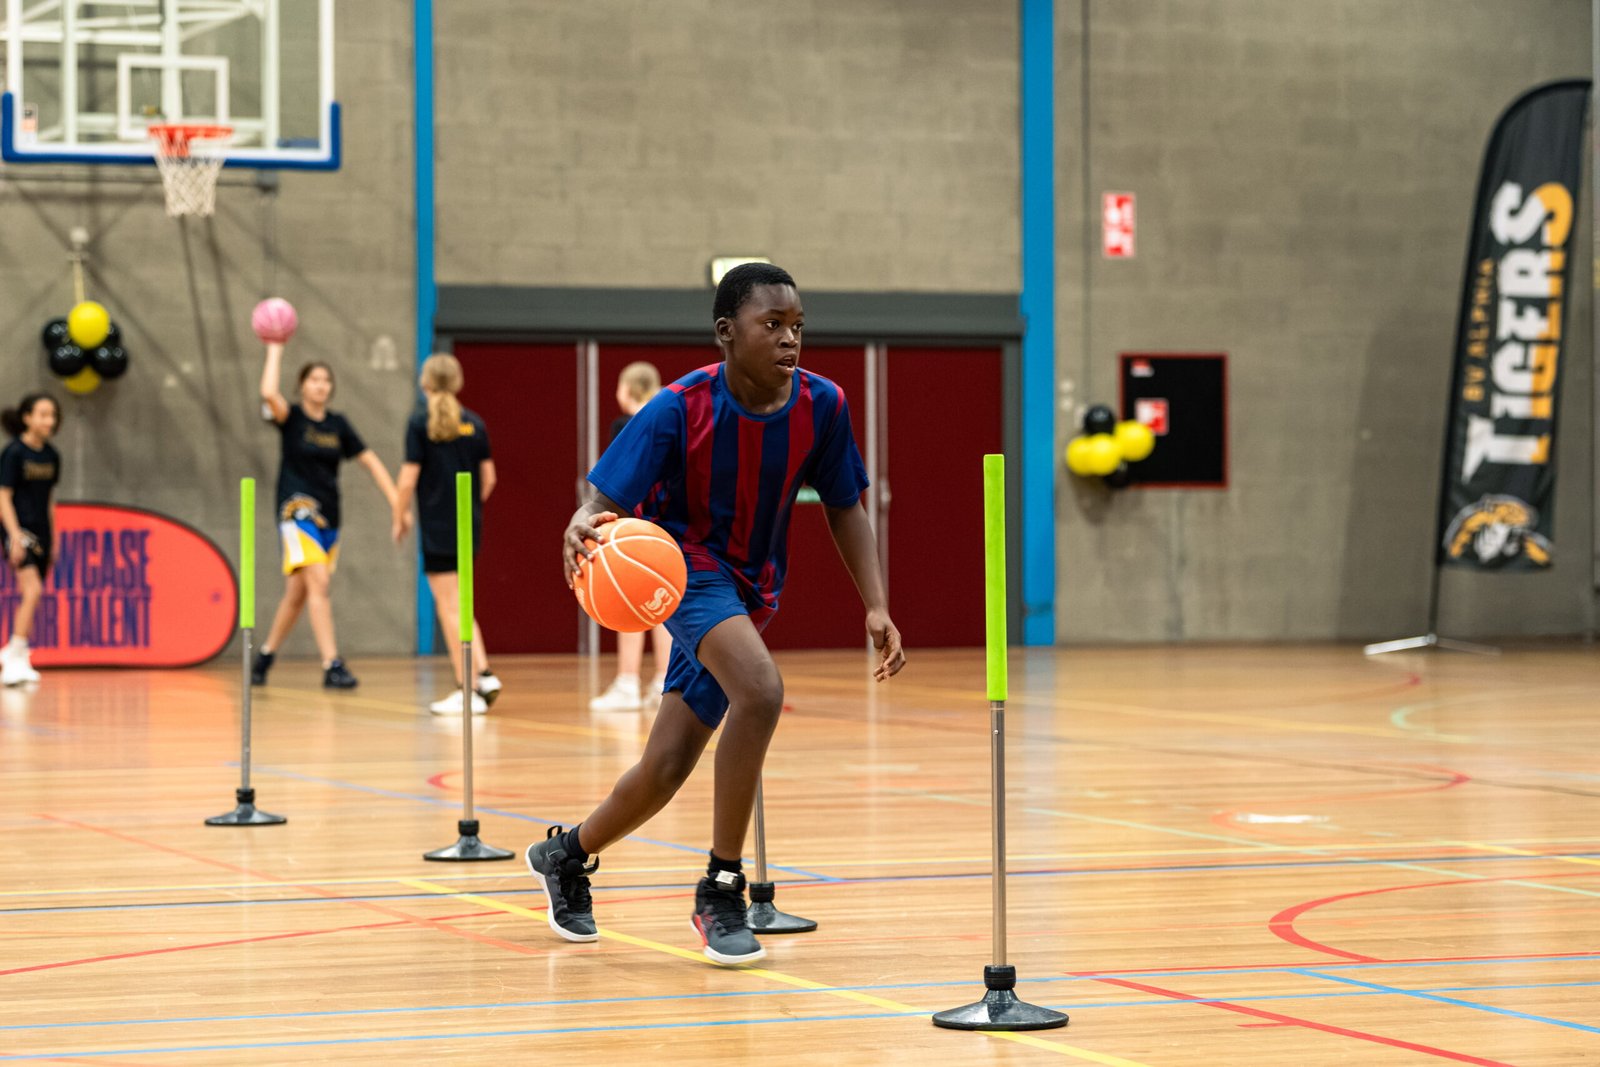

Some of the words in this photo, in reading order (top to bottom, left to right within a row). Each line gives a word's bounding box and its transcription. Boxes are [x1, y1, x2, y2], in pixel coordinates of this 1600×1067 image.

[1462, 181, 1573, 483] TIGERS
[0, 529, 152, 590] WCASE
[69, 594, 151, 648] TALENT
